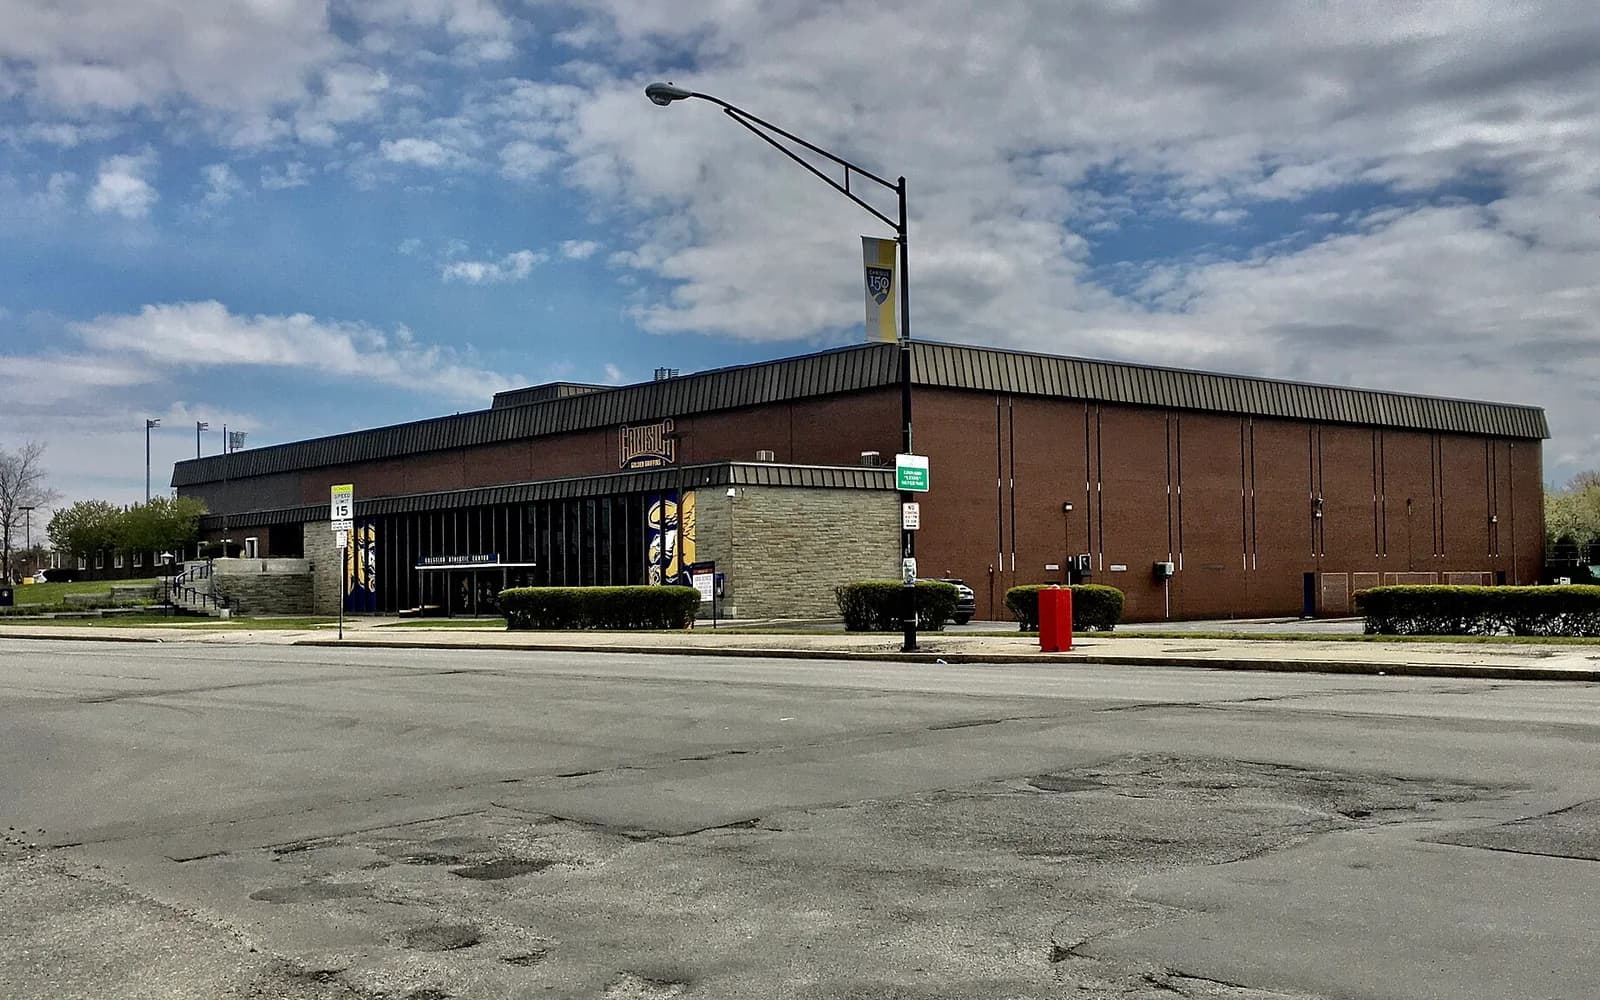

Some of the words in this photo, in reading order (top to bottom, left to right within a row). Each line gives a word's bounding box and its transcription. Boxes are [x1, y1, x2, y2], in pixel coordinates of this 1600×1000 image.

[869, 275, 890, 291] 150
[619, 418, 675, 468] CANISIUS
[336, 505, 349, 517] 15
